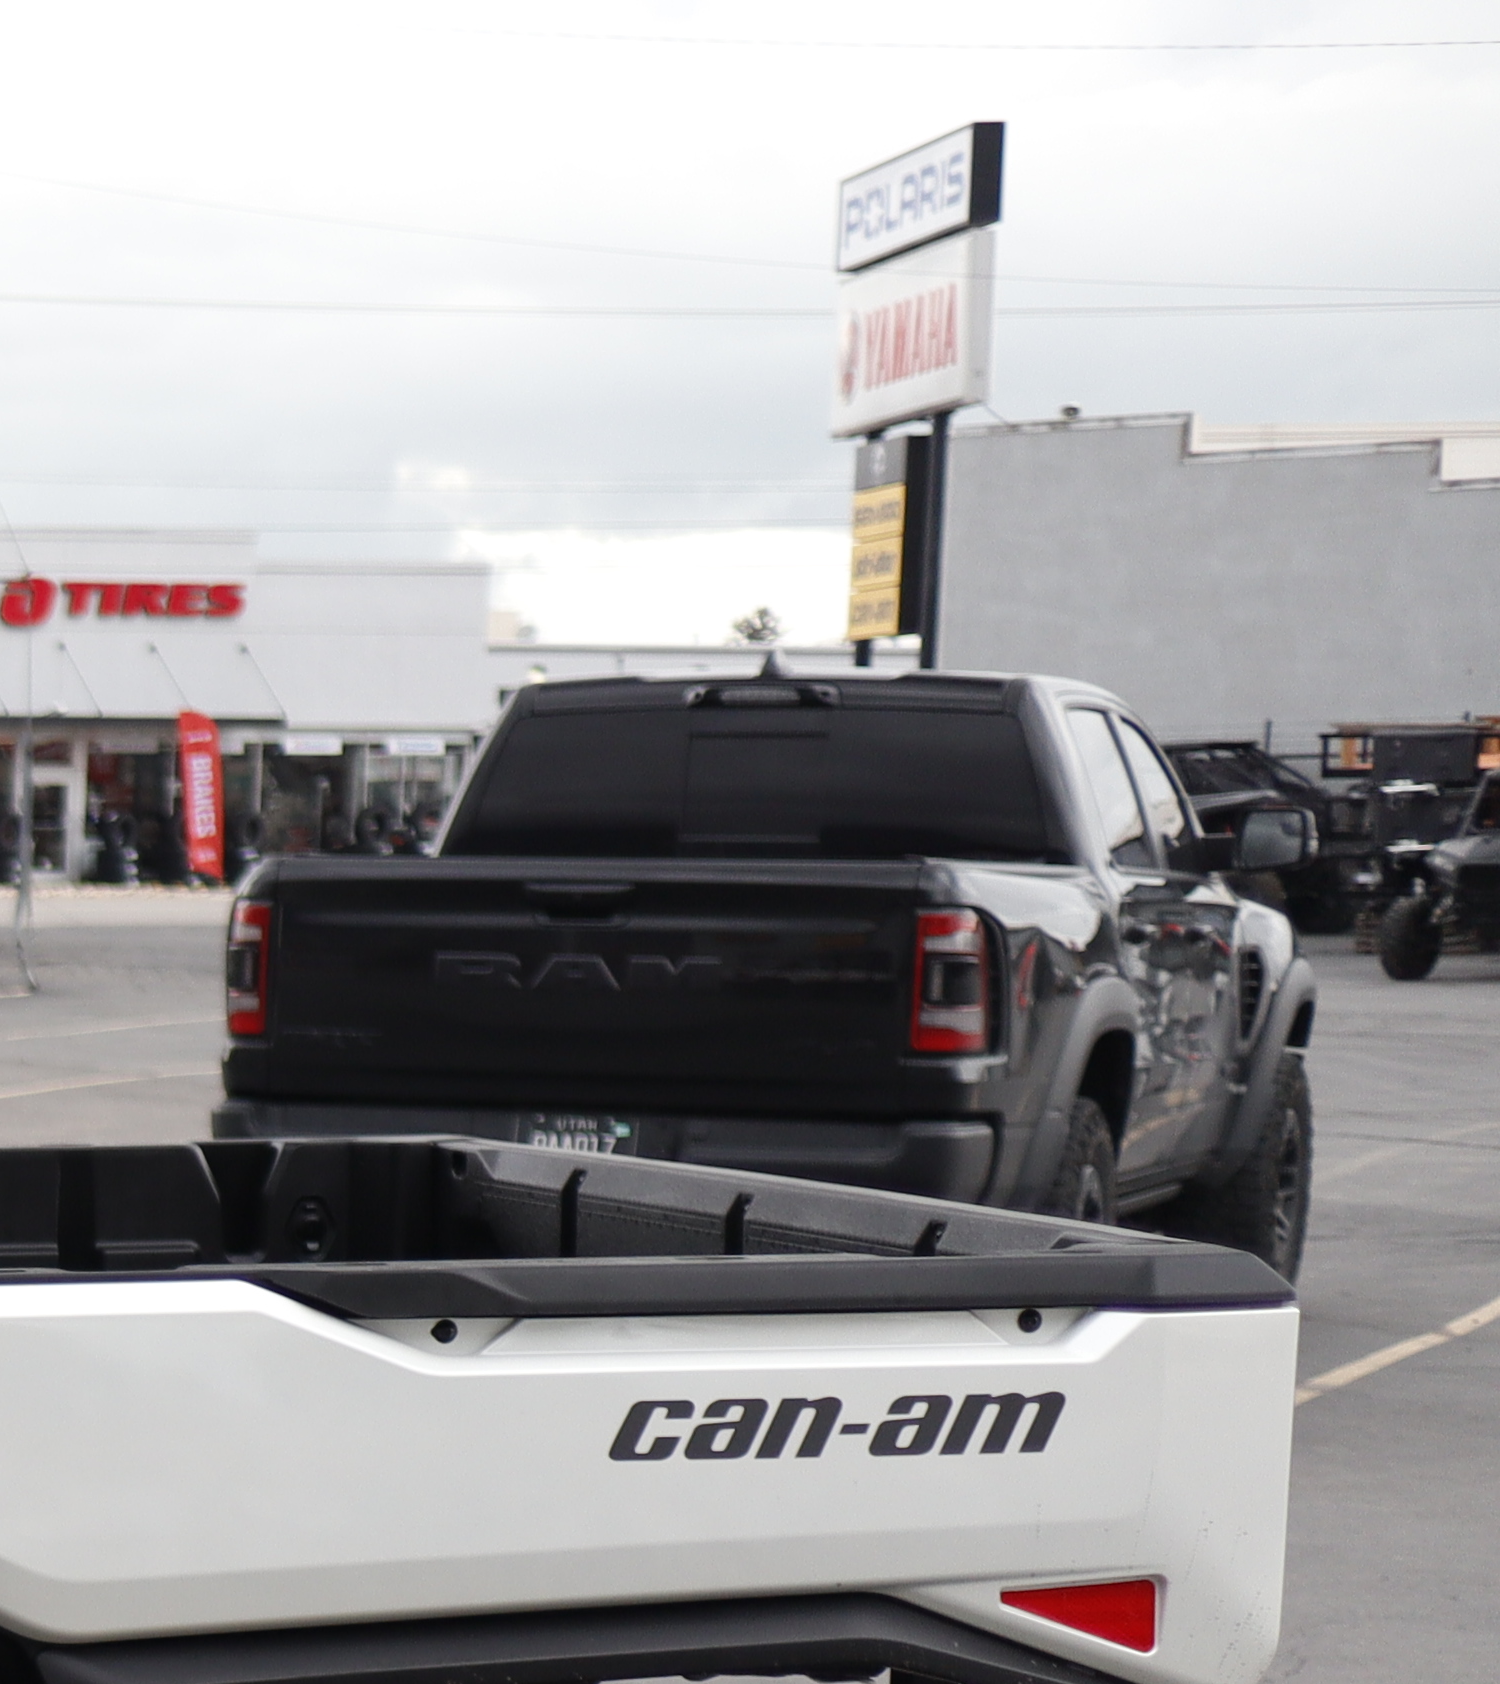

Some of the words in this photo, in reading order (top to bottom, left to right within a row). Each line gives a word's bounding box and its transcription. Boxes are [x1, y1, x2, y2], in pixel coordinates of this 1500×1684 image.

[844, 154, 964, 248] POLARIS
[864, 282, 958, 391] YAMAHA
[0, 577, 56, 627] O
[62, 582, 247, 617] TIRES
[190, 753, 217, 839] BRAKES
[434, 949, 723, 993] RAM
[555, 1117, 598, 1132] UTAH
[608, 1390, 1066, 1462] can-am
